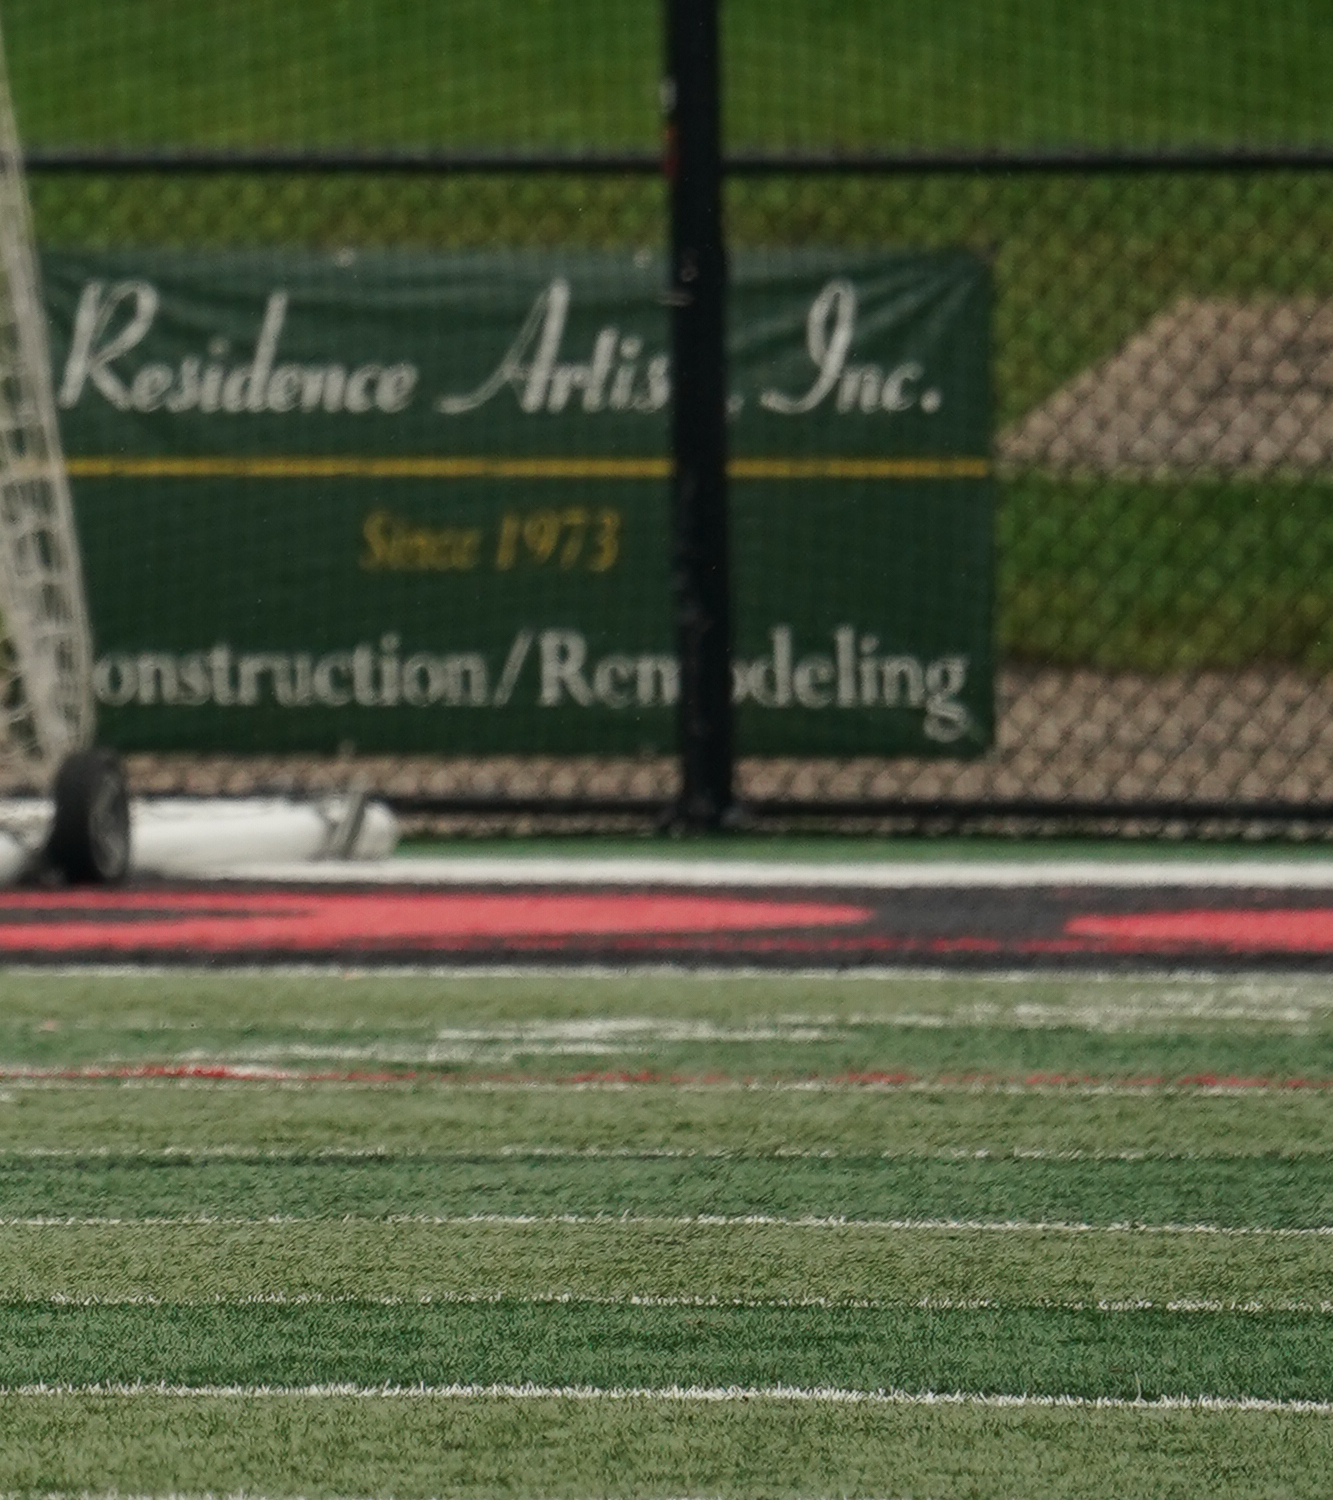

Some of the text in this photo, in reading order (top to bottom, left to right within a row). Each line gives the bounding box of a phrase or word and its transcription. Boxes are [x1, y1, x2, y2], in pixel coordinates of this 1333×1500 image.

[57, 278, 421, 413] Residence
[760, 277, 942, 414] Inc.
[92, 624, 970, 742] onstruction/Remdeling
